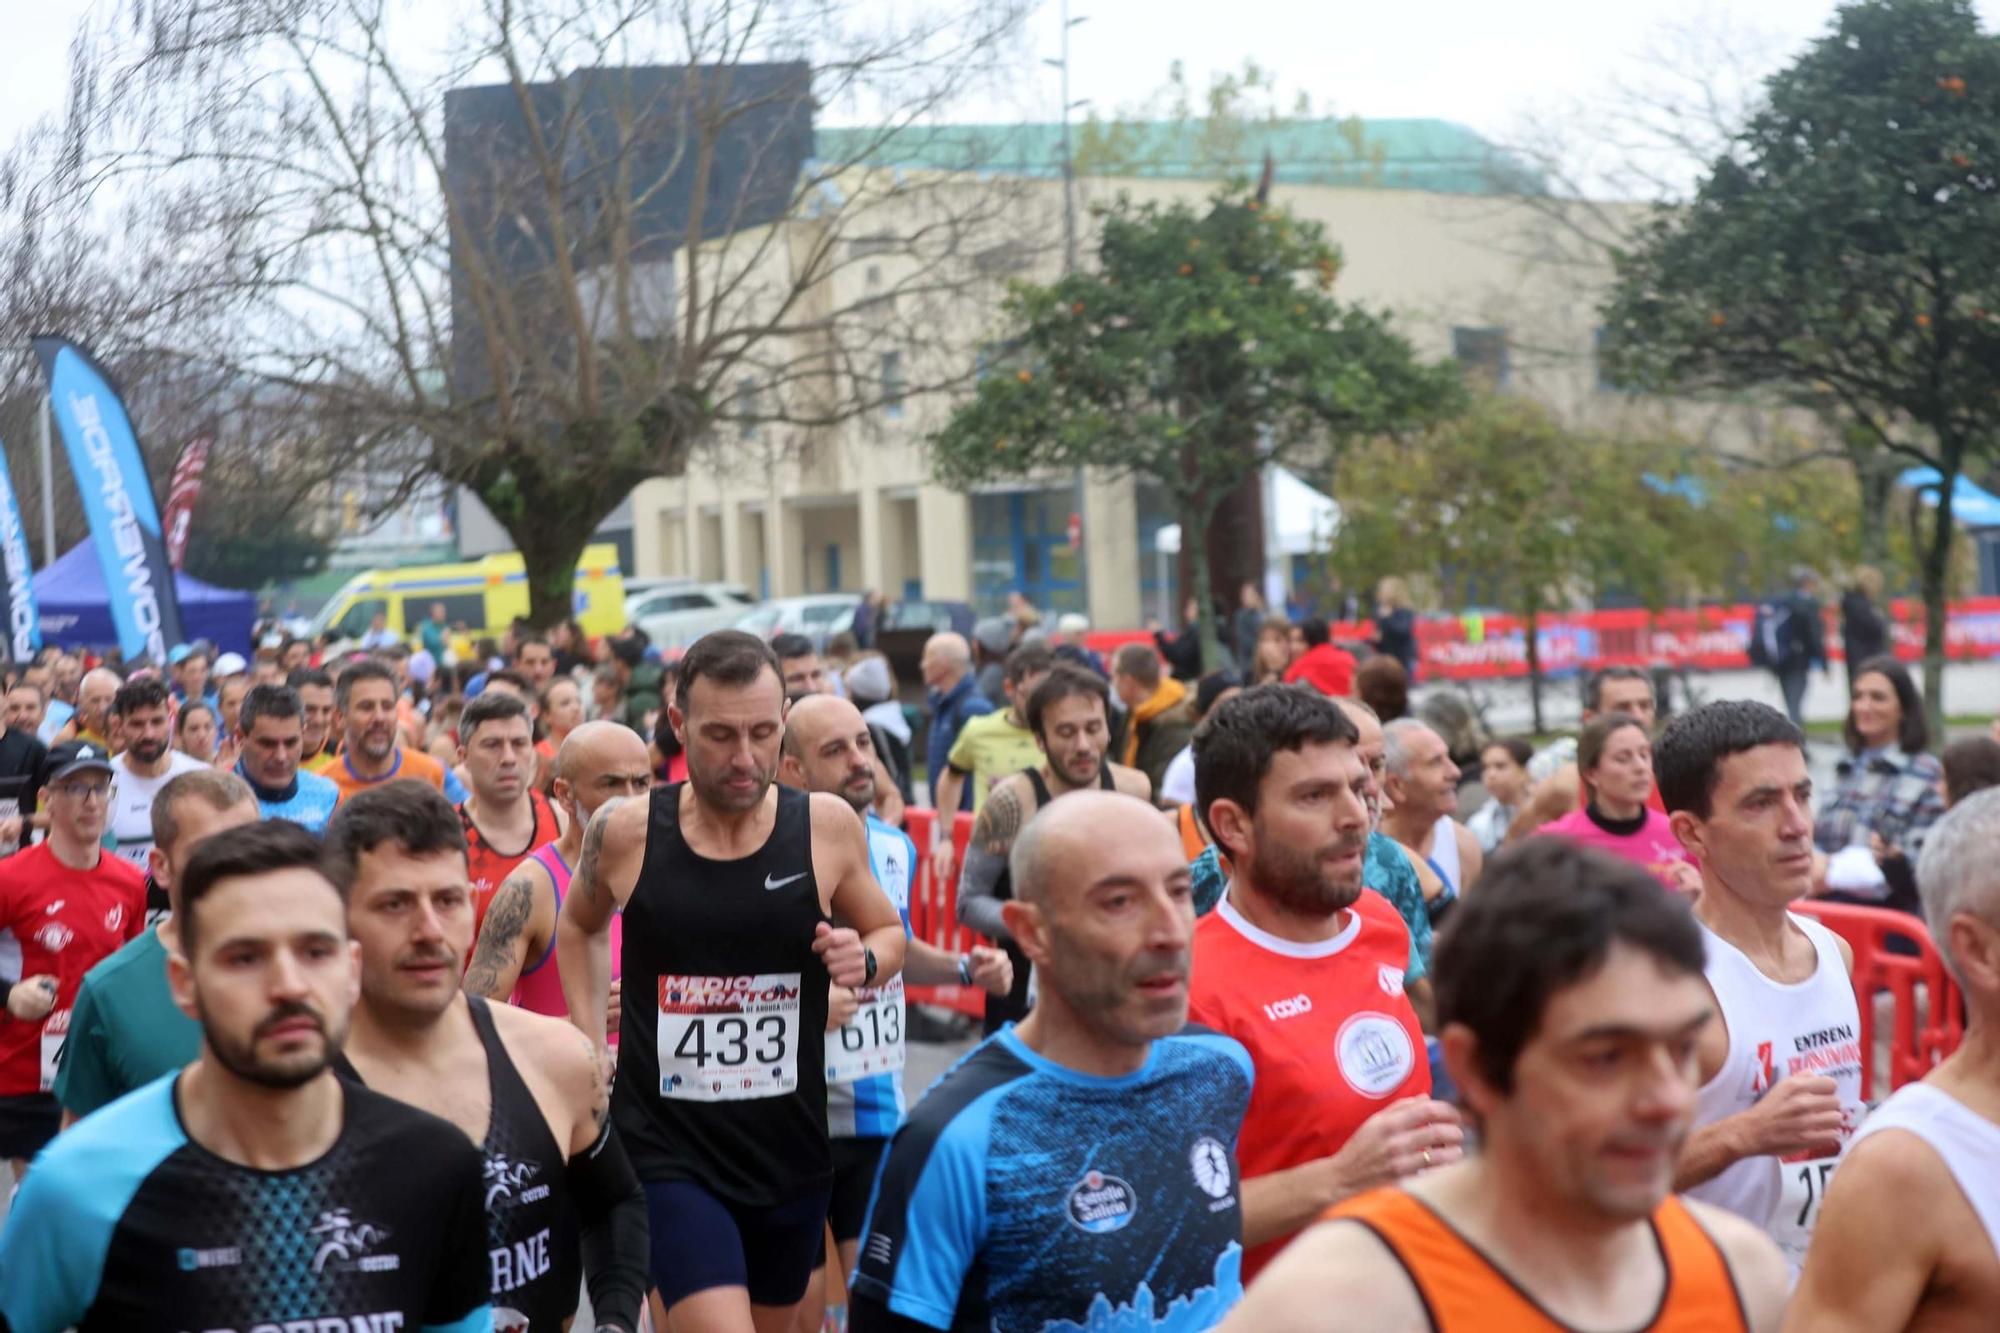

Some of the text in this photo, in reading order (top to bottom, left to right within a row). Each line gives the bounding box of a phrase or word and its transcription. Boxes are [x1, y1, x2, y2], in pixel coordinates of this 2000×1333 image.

[665, 976, 753, 991] MEDIO
[674, 1016, 786, 1067] 433
[841, 1005, 899, 1052] 613
[1794, 1024, 1853, 1052] ENTRENA
[489, 1228, 550, 1294] RNE
